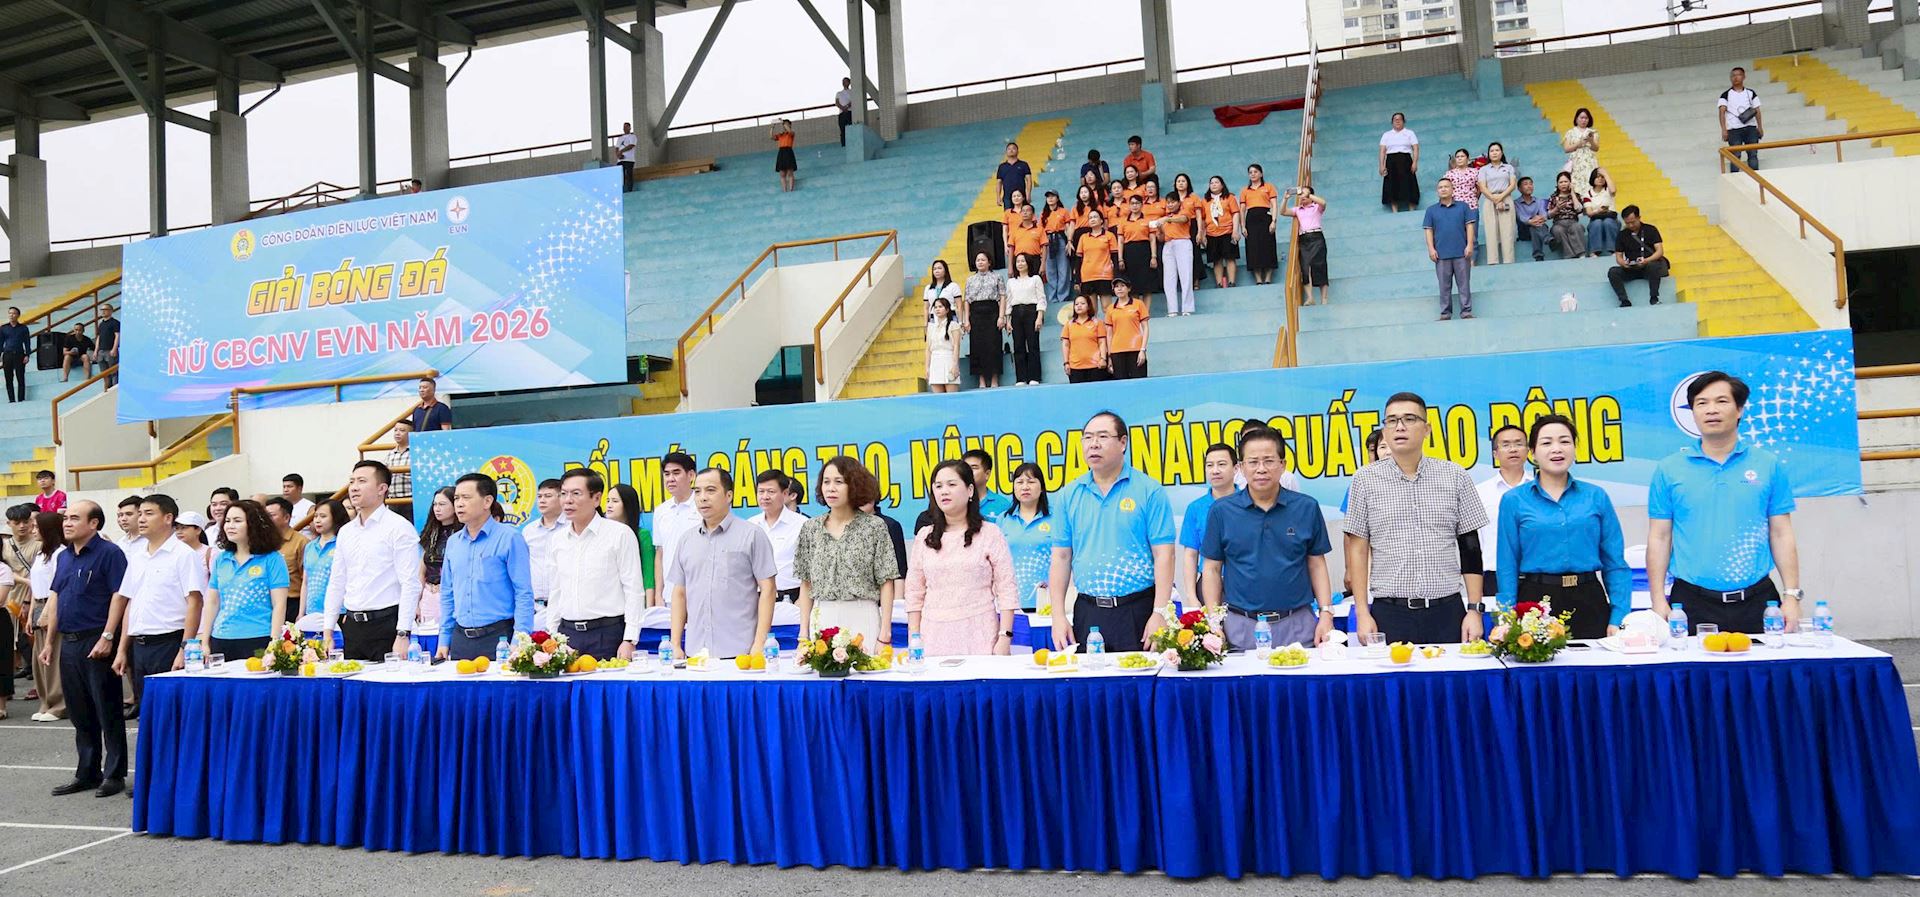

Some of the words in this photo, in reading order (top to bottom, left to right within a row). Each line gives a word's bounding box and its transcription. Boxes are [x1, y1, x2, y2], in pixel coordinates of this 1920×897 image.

[262, 230, 292, 247] CÔNG
[295, 223, 325, 241] ĐOÀN
[328, 218, 353, 237] ĐIỆN
[357, 217, 378, 234] LỰC
[381, 212, 407, 230] VIỆT
[410, 211, 437, 225] NAM
[449, 225, 468, 234] EVN
[247, 266, 304, 315] GIẢI
[308, 258, 394, 308] BÓNG
[399, 247, 448, 297] ĐÁ
[168, 339, 208, 375] NỮ
[213, 331, 308, 369] CBCNV
[316, 324, 377, 357] EVN
[387, 311, 462, 351] NĂM
[471, 308, 549, 343] 2026
[564, 437, 620, 514] ỔI
[1035, 429, 1088, 493] CA
[1423, 403, 1479, 471] AO
